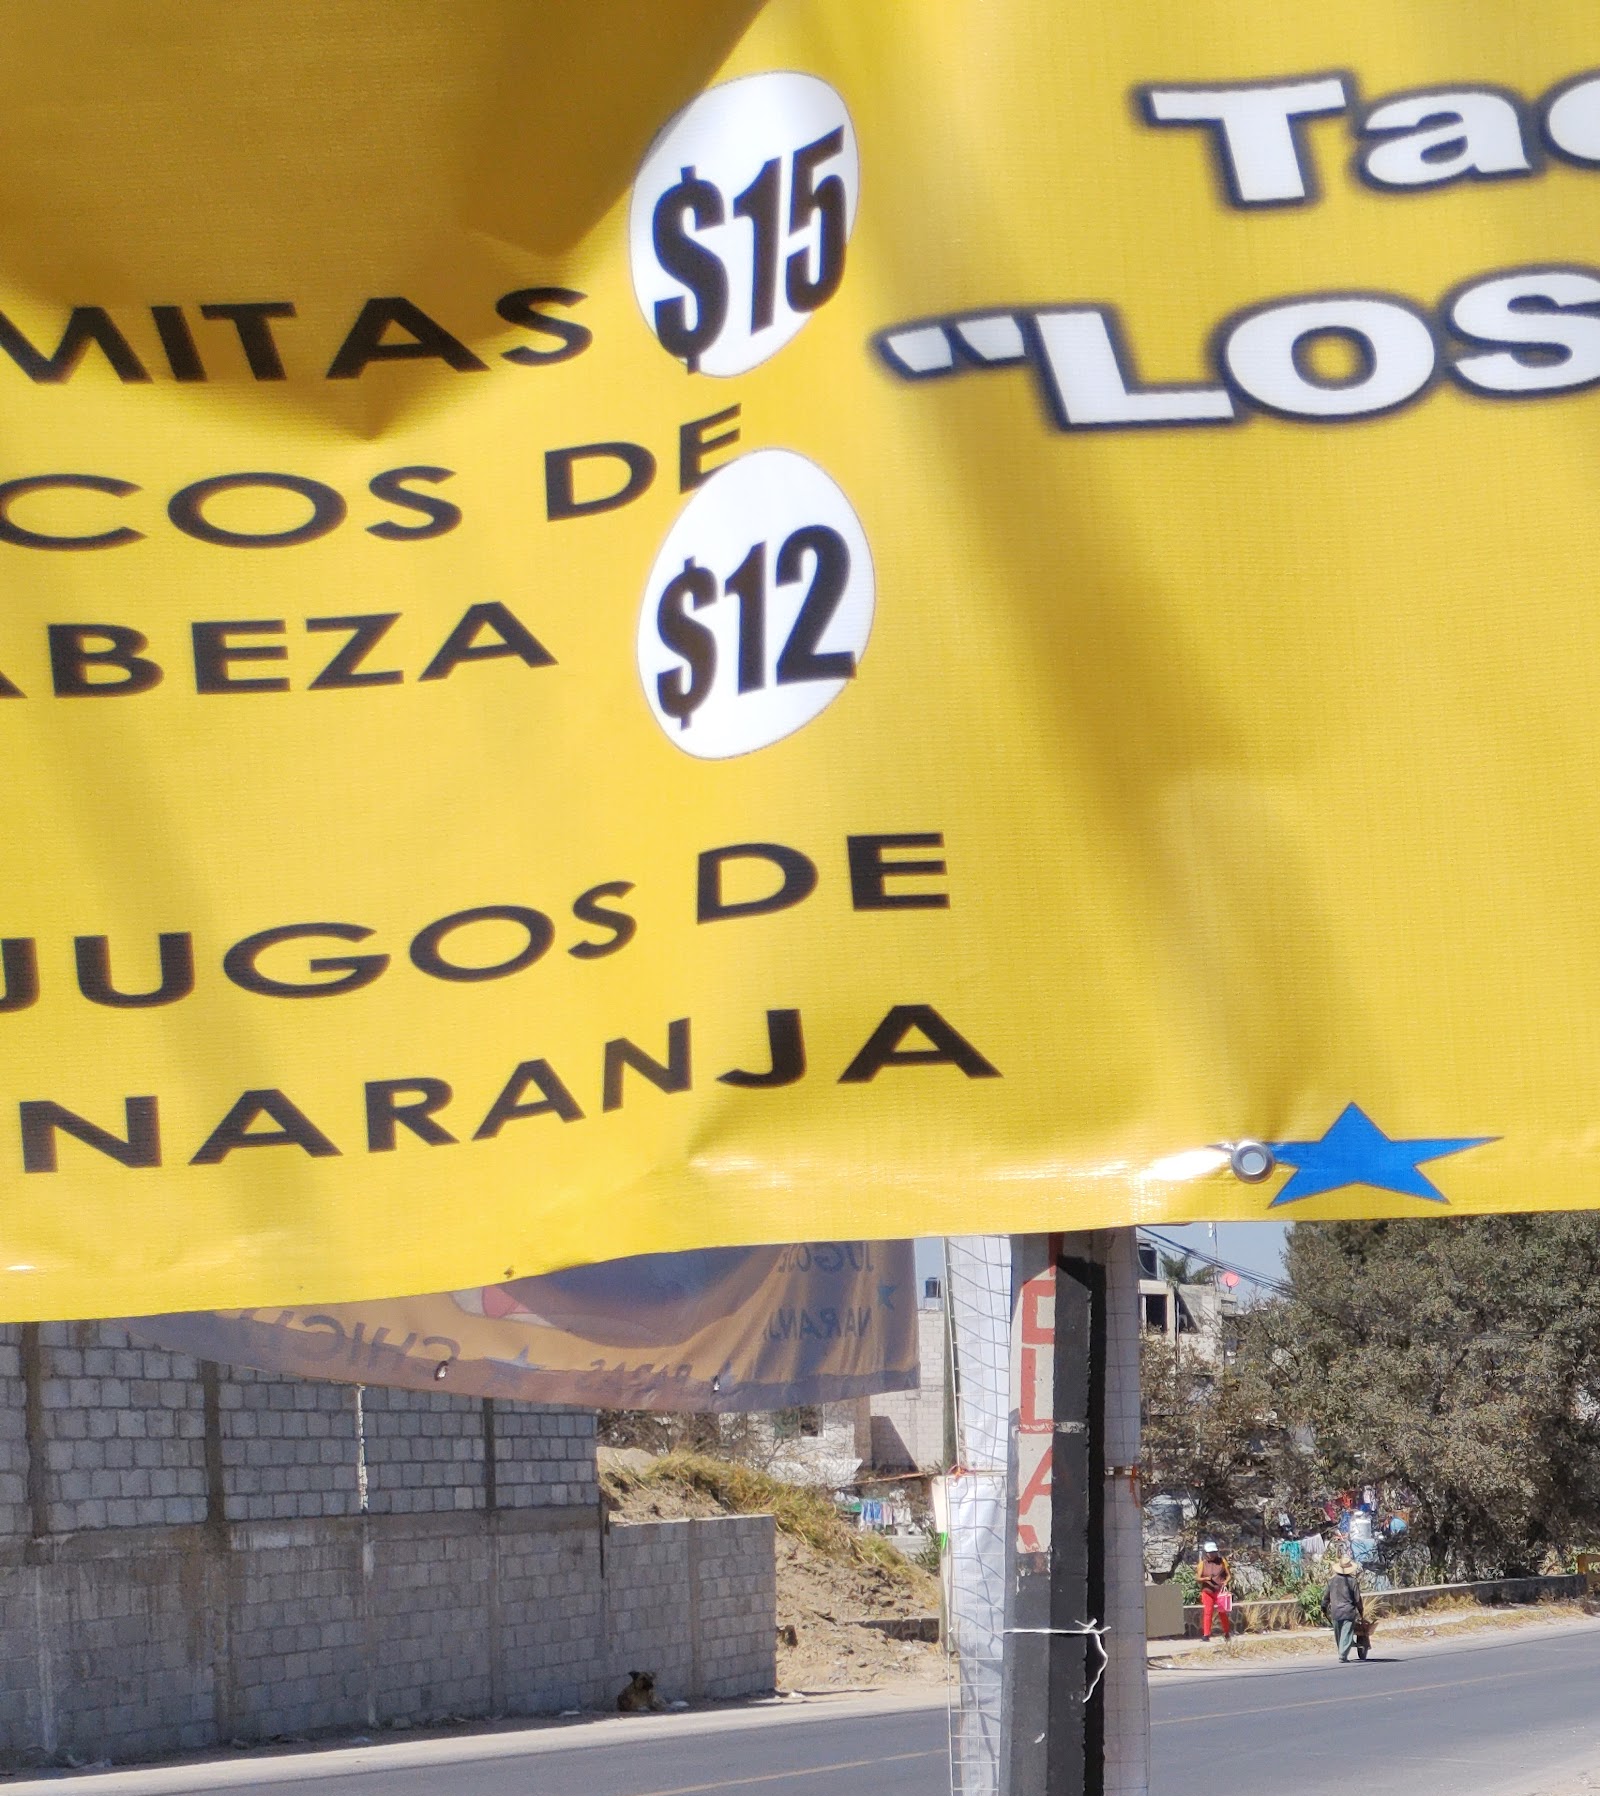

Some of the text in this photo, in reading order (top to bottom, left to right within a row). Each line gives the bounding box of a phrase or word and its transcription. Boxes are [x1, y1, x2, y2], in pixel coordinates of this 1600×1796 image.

[651, 125, 847, 374] $15
[0, 286, 592, 384] MITAS
[0, 402, 742, 550] COS DE
[0, 601, 558, 698] BEZA
[655, 525, 857, 731] $12
[0, 832, 950, 1014] JUGOS DE
[19, 1003, 1003, 1173] NARANJA
